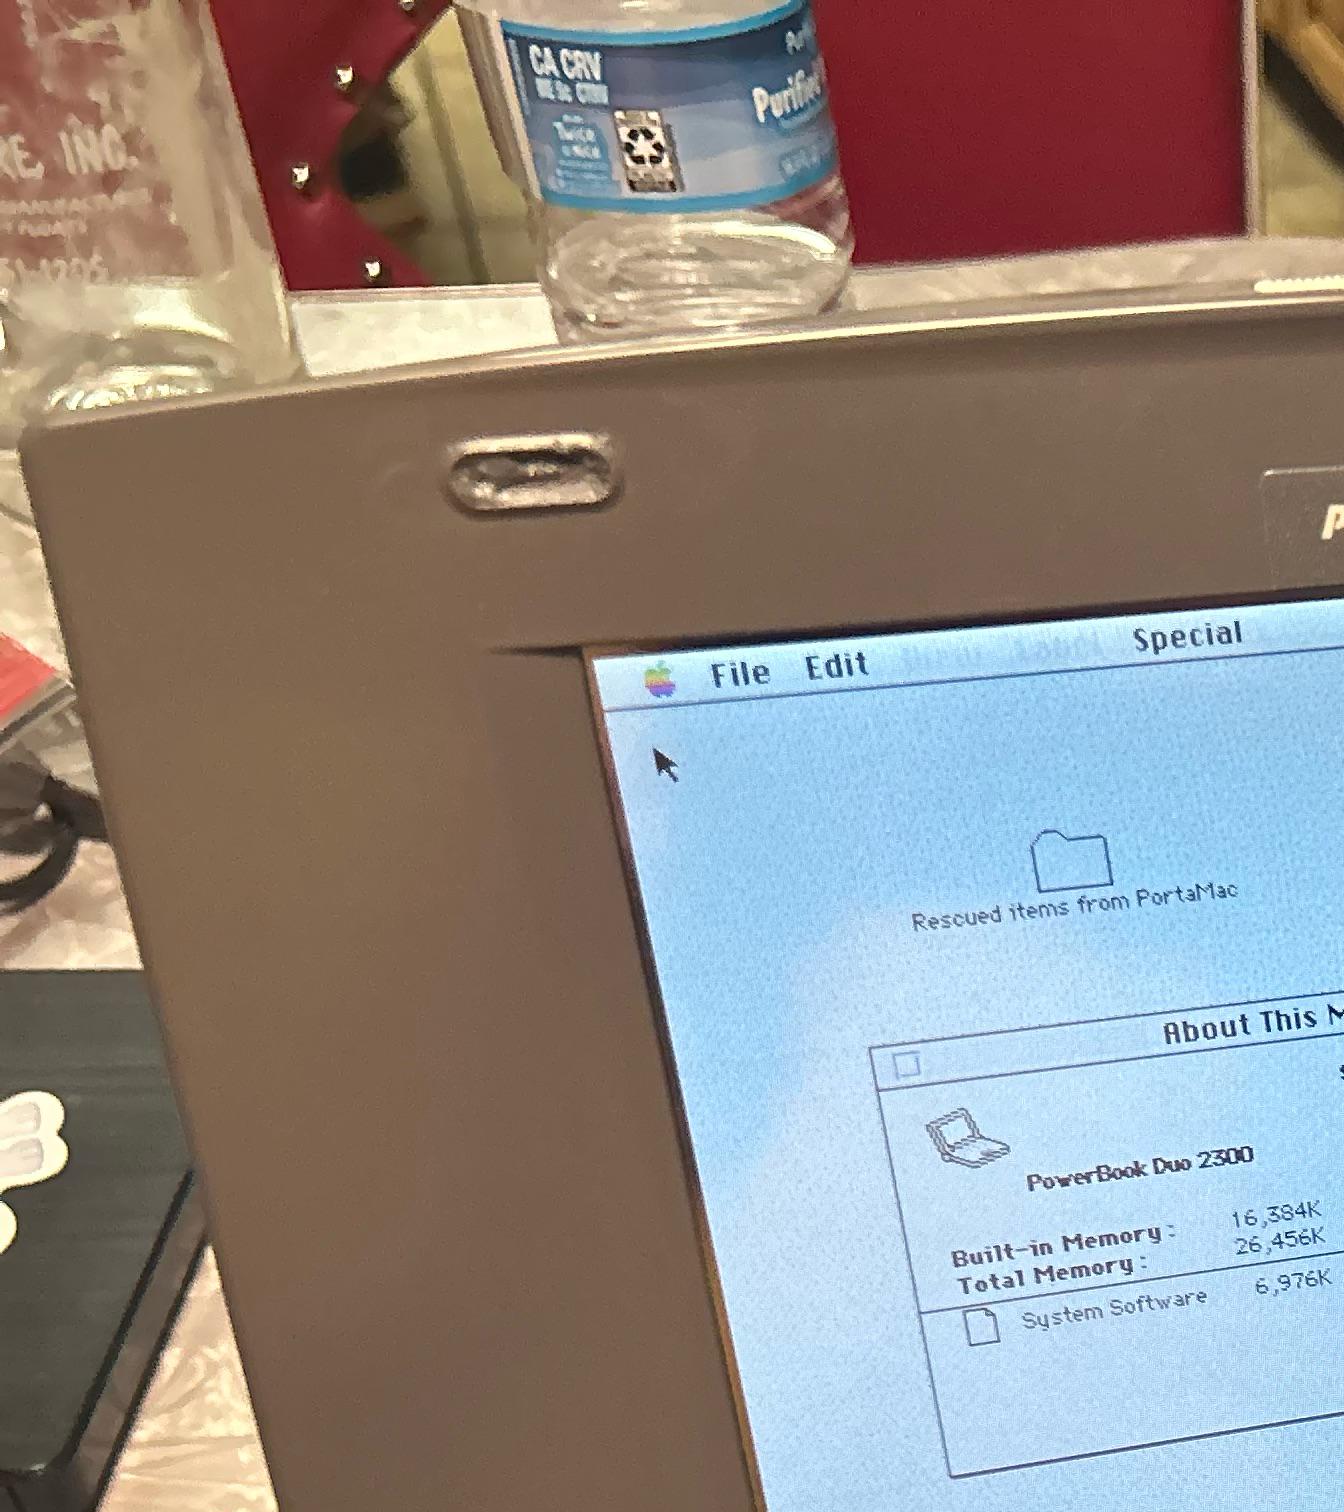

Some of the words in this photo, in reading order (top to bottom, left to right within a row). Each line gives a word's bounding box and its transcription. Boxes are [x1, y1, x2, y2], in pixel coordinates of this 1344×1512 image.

[530, 44, 560, 79] CA
[560, 48, 602, 81] CRV
[710, 659, 771, 689] File
[805, 651, 869, 681] Edit
[1133, 620, 1243, 655] Special
[912, 902, 1002, 932] Rescued
[1009, 897, 1069, 922] items
[1076, 890, 1130, 914] from
[1136, 879, 1238, 908] PortaMac
[1163, 1014, 1249, 1045] About
[1260, 1005, 1317, 1034] This
[1026, 1161, 1148, 1192] PowerBook
[1152, 1154, 1192, 1176] Duo
[1197, 1145, 1255, 1170] 2300
[951, 1238, 1053, 1269] Built-in
[1232, 1199, 1323, 1230] 16,384K
[957, 1269, 1024, 1295] Total
[1235, 1226, 1327, 1257] 26,456K
[1022, 1305, 1104, 1333] System
[1110, 1287, 1208, 1315] Software
[1255, 1269, 1334, 1297] 6,976K
